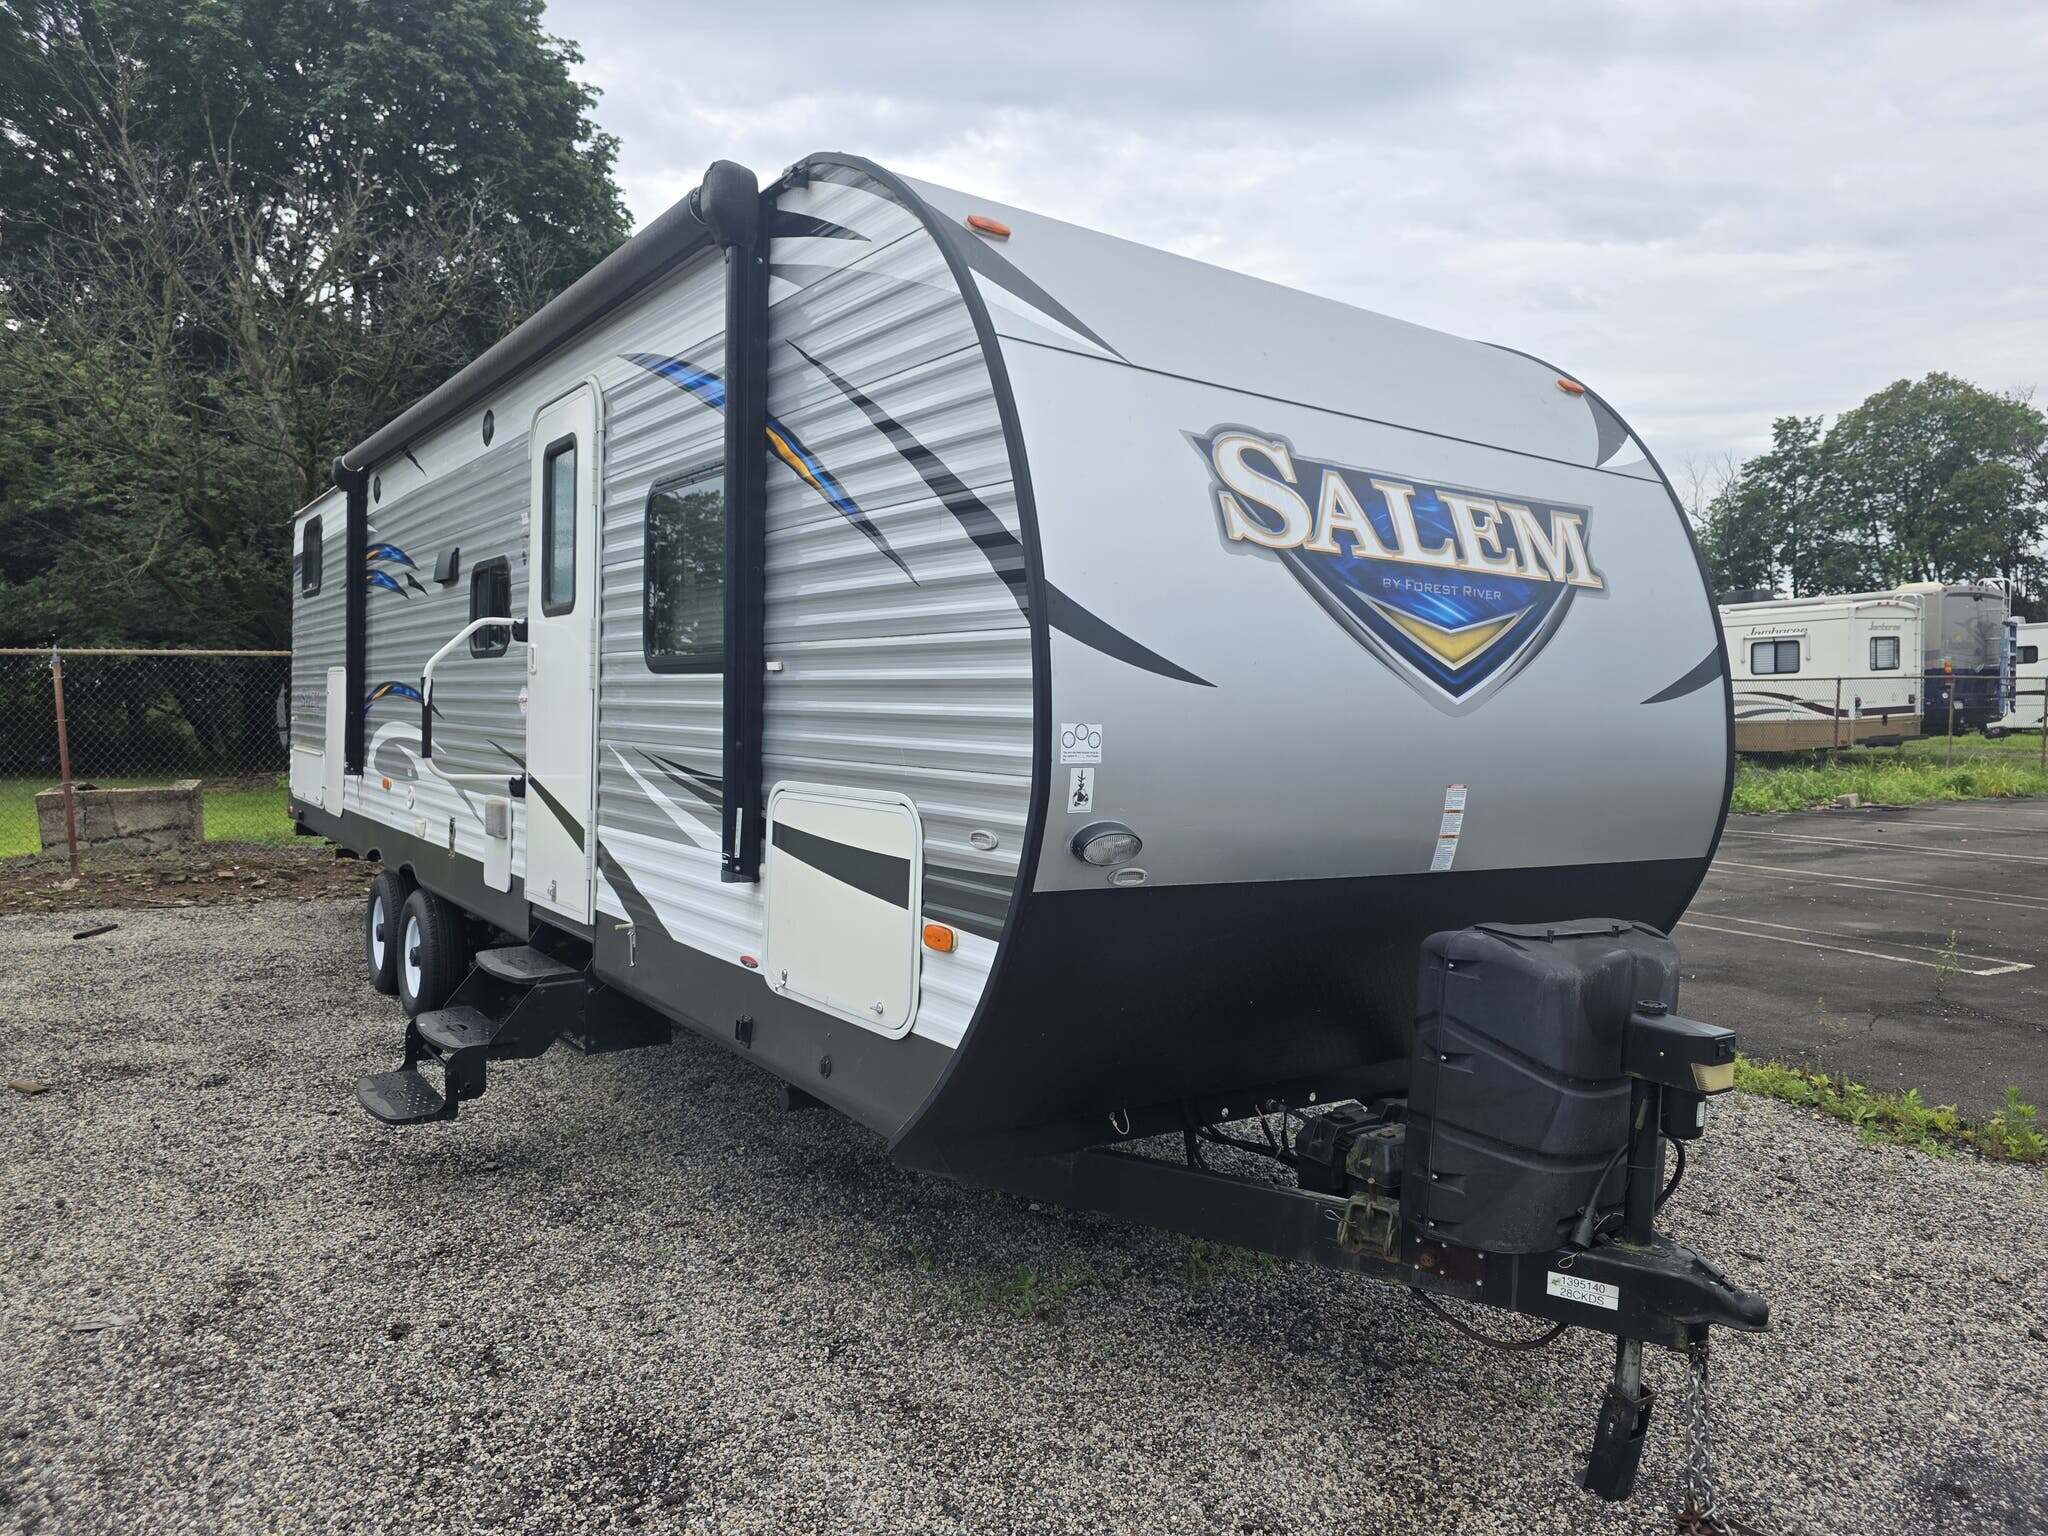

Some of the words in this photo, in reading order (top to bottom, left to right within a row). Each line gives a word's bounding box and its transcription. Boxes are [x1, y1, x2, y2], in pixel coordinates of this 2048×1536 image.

[1213, 430, 1604, 589] SALEM
[1405, 578, 1458, 596] FOREST
[1463, 585, 1502, 601] RIVER
[1562, 1277, 1605, 1294] 1395140
[1560, 1288, 1604, 1305] 28CKDS
